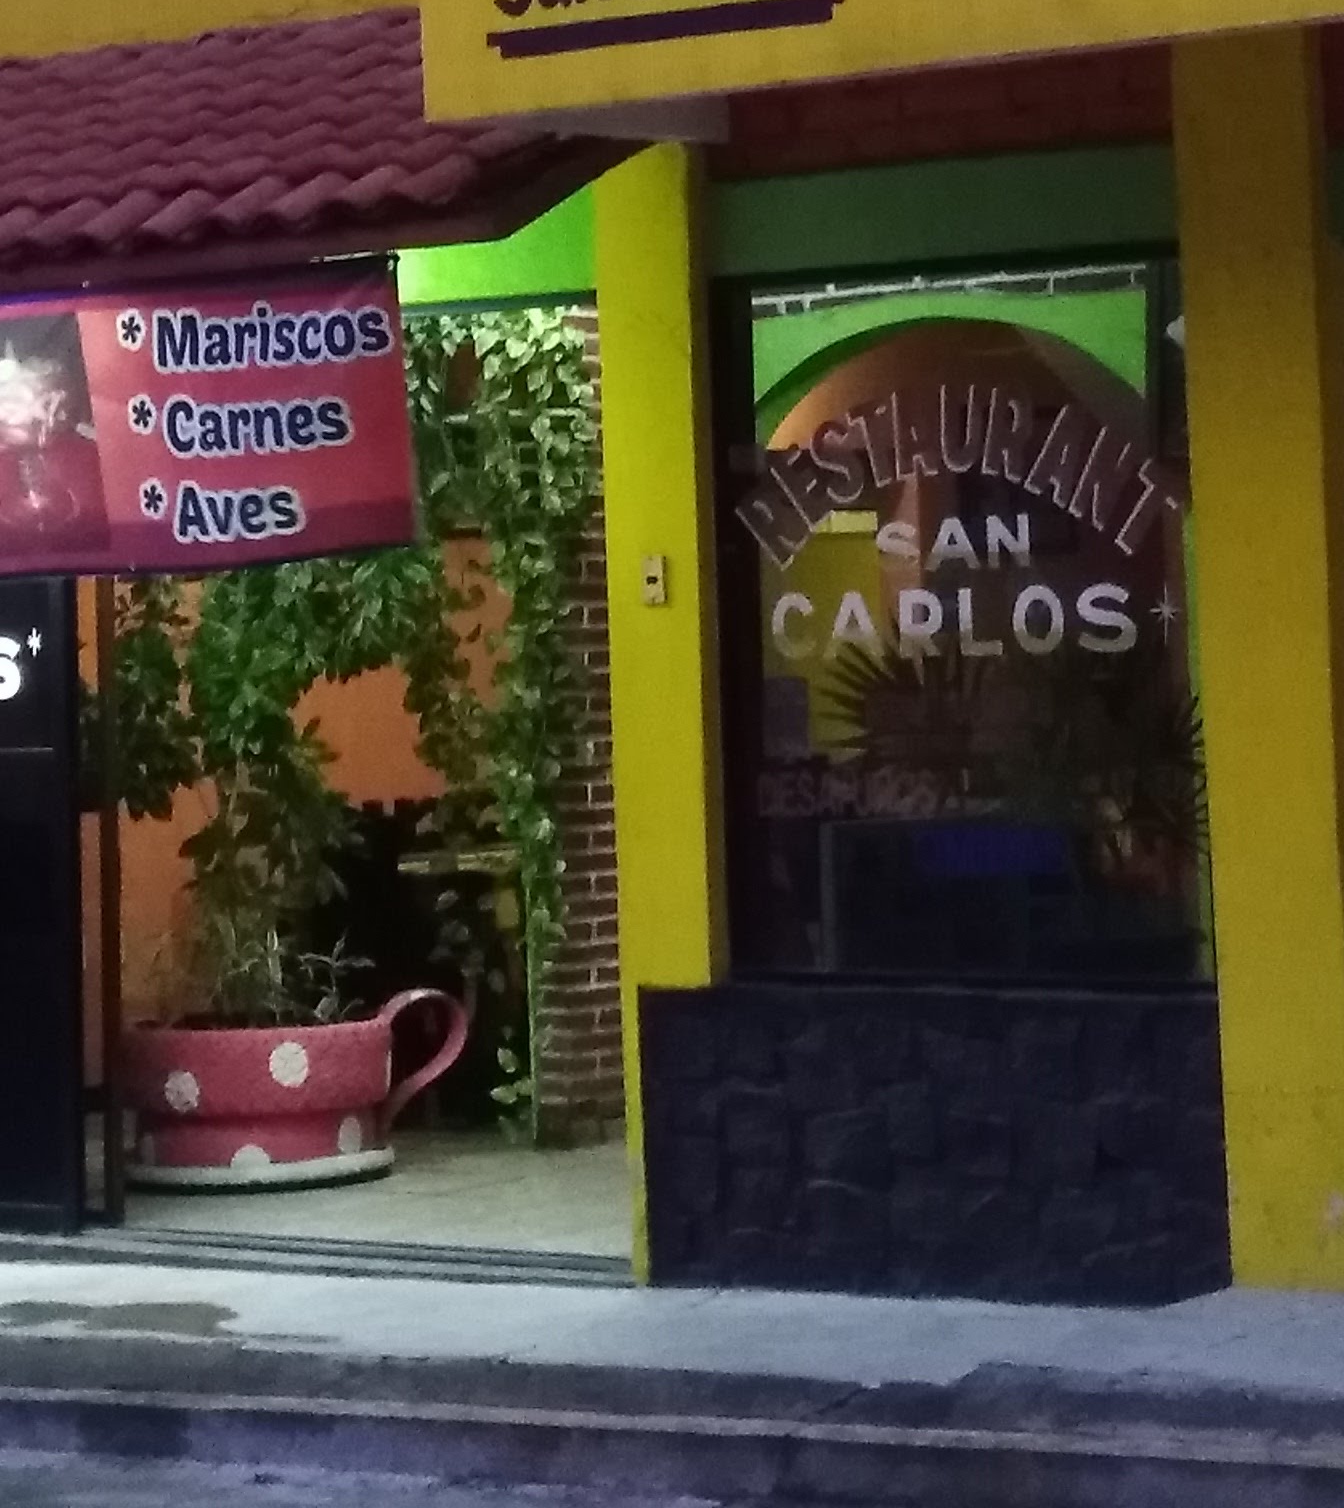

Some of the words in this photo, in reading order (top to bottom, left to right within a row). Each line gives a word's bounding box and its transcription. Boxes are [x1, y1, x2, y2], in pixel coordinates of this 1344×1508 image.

[153, 304, 392, 370] Mariscos
[164, 397, 352, 454] Carnes
[735, 384, 1179, 571] RESTAURANT
[176, 483, 301, 540] Aves
[876, 513, 1030, 570] SAN
[771, 581, 1138, 661] CARLOS
